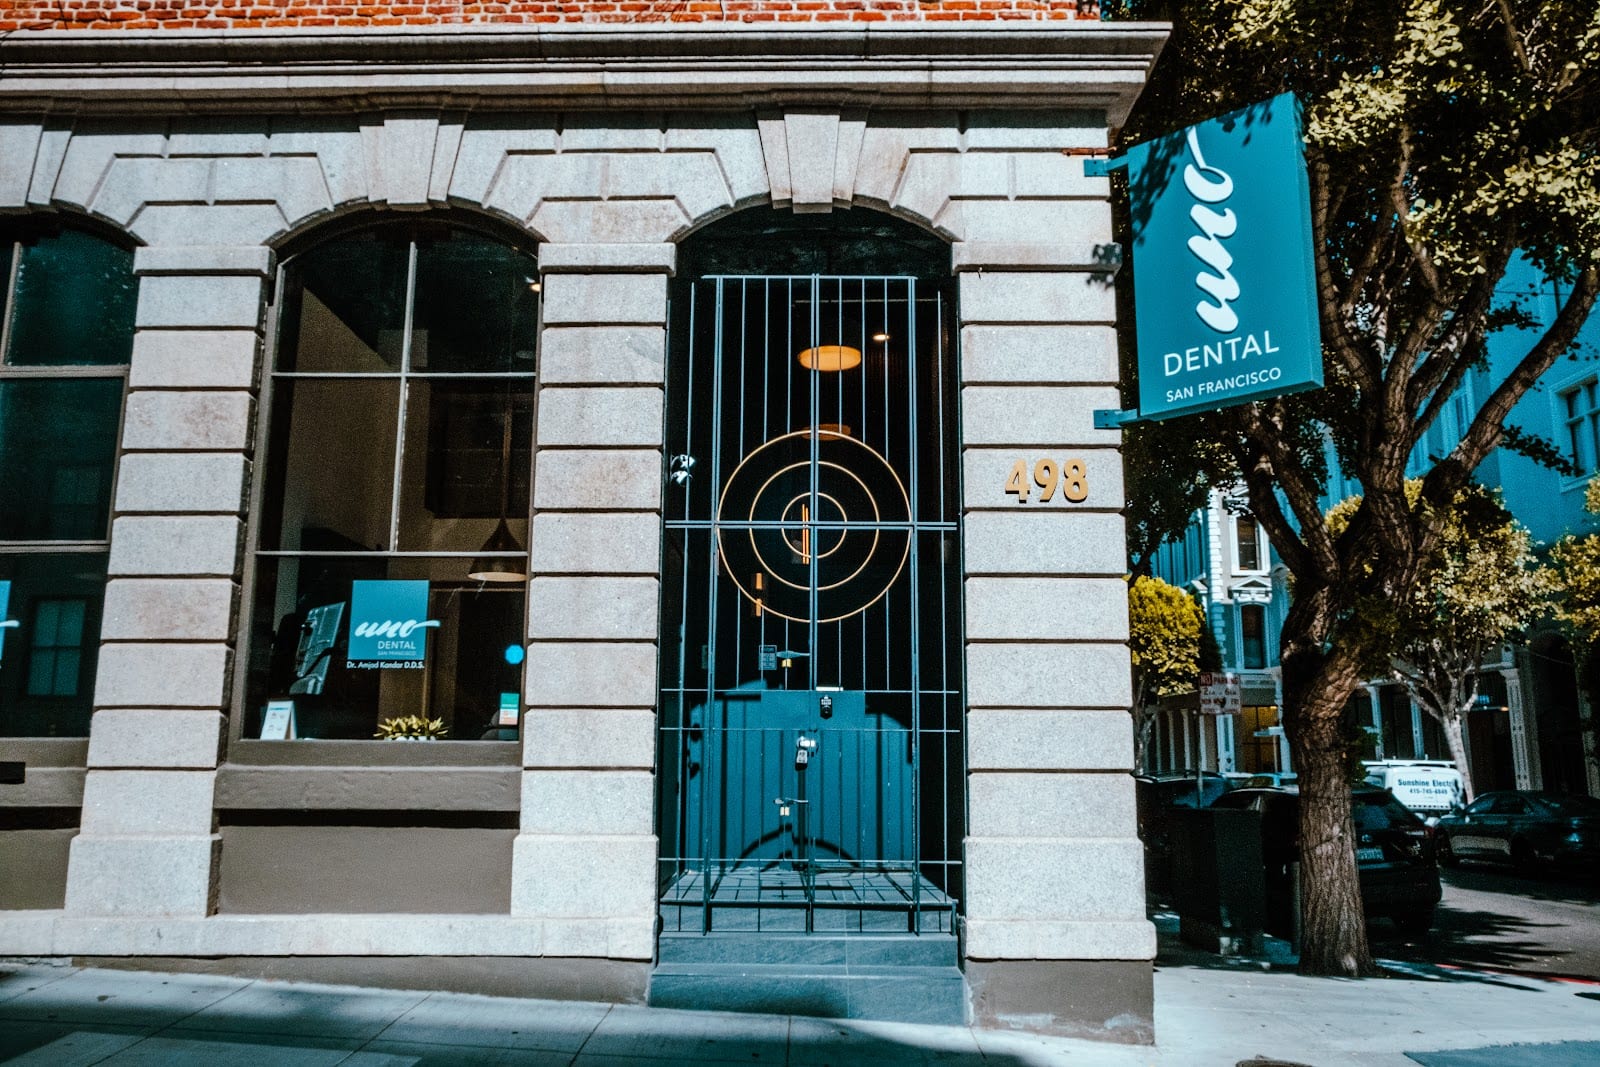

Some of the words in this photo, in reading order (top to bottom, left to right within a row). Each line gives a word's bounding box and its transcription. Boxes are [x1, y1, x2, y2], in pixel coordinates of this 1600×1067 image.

[1164, 330, 1280, 377] DENTAL
[1166, 386, 1194, 403] SAN
[1198, 367, 1282, 396] FRANCISCO
[1004, 457, 1089, 503] 498
[354, 619, 440, 638] uno
[377, 640, 417, 650] DENTAL
[346, 661, 357, 669] Dr.
[404, 661, 425, 669] D.D.S.
